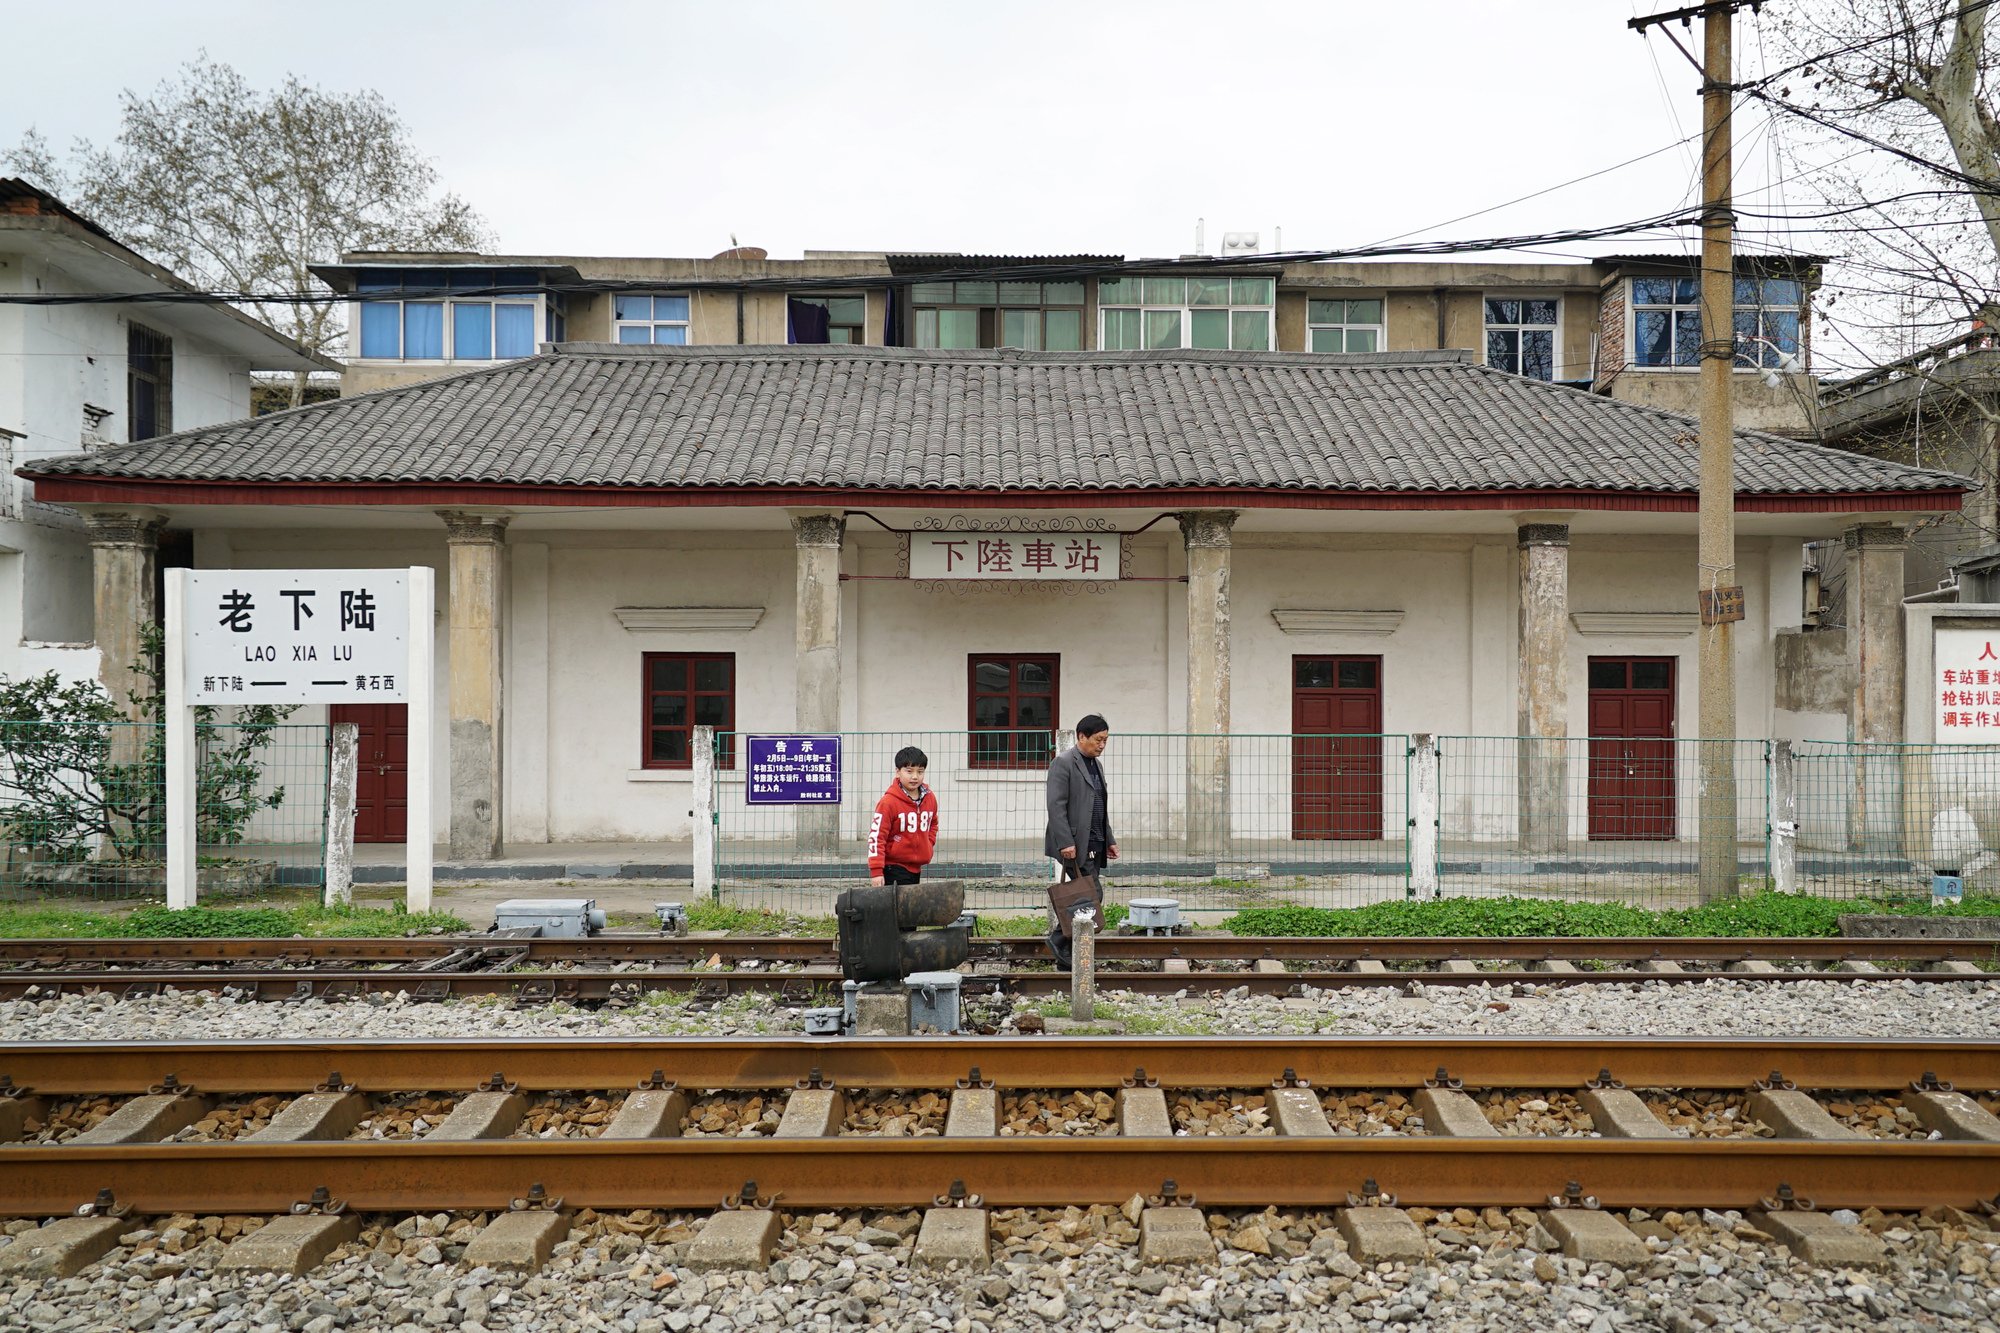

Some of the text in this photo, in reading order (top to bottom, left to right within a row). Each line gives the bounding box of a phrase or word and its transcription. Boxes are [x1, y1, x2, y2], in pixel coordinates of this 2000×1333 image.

[931, 537, 1102, 573] 下陸車站
[218, 588, 376, 632] 老下陆
[245, 645, 353, 662] LAO XIA LU
[203, 675, 395, 692] 新下陆 黄石西
[775, 740, 814, 753] 告示
[898, 811, 934, 833] 1987
